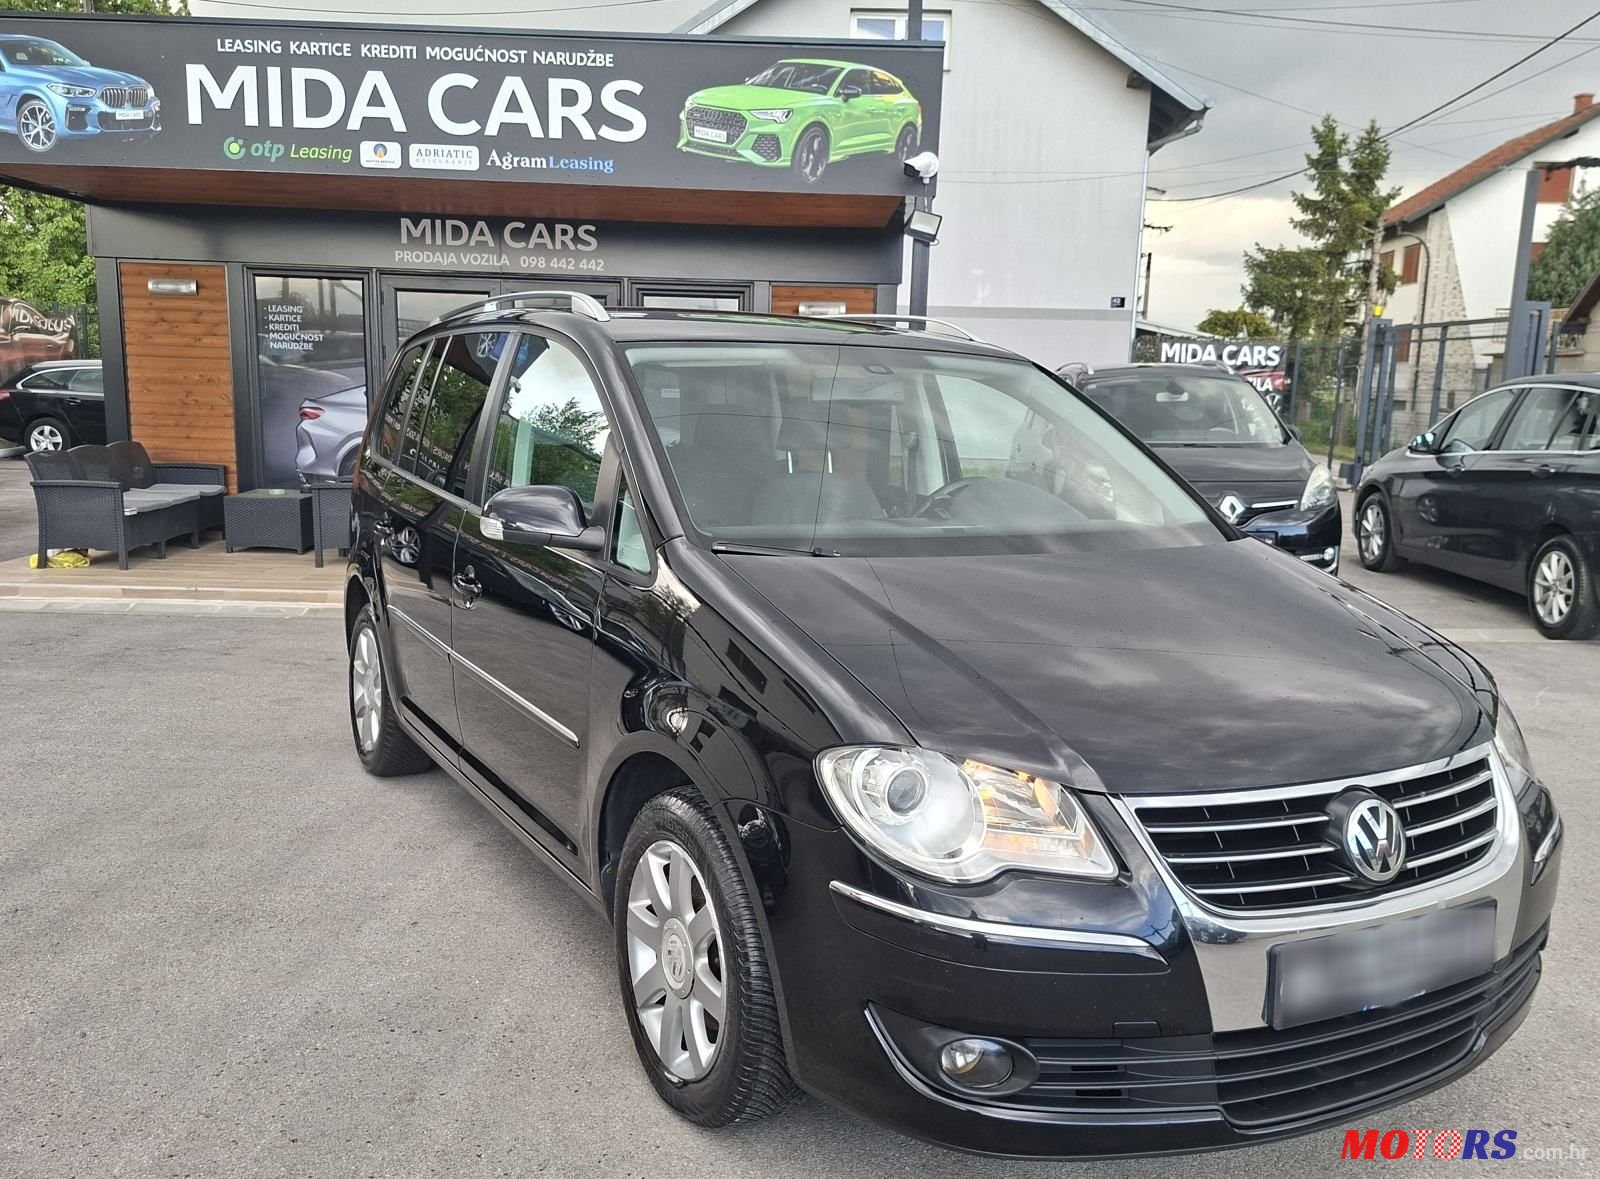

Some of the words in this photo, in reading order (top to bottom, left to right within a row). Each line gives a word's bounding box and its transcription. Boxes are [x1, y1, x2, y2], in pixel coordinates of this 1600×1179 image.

[216, 38, 282, 55] LEASING
[289, 41, 352, 57] KARTICE
[360, 44, 417, 60] KREDITI
[425, 44, 527, 64] MOGUĆNOST
[532, 48, 614, 68] NARUDŽBE
[185, 63, 407, 133] MIDA
[427, 72, 648, 143] CARS
[251, 139, 284, 162] otp
[290, 143, 353, 163] Leasing
[416, 148, 473, 159] ADRIATIC
[400, 217, 495, 248] MIDA
[503, 221, 598, 251] CARS
[395, 250, 458, 266] PRODAJA
[460, 253, 511, 267] VOZILA
[520, 255, 546, 268] 098
[550, 257, 576, 270] 442
[579, 258, 605, 271] 442
[268, 304, 303, 313] LEASING
[268, 314, 302, 322] KARTICE
[269, 323, 300, 331] KREDITI
[1161, 342, 1217, 363] MIDA
[1222, 344, 1282, 367] CARS
